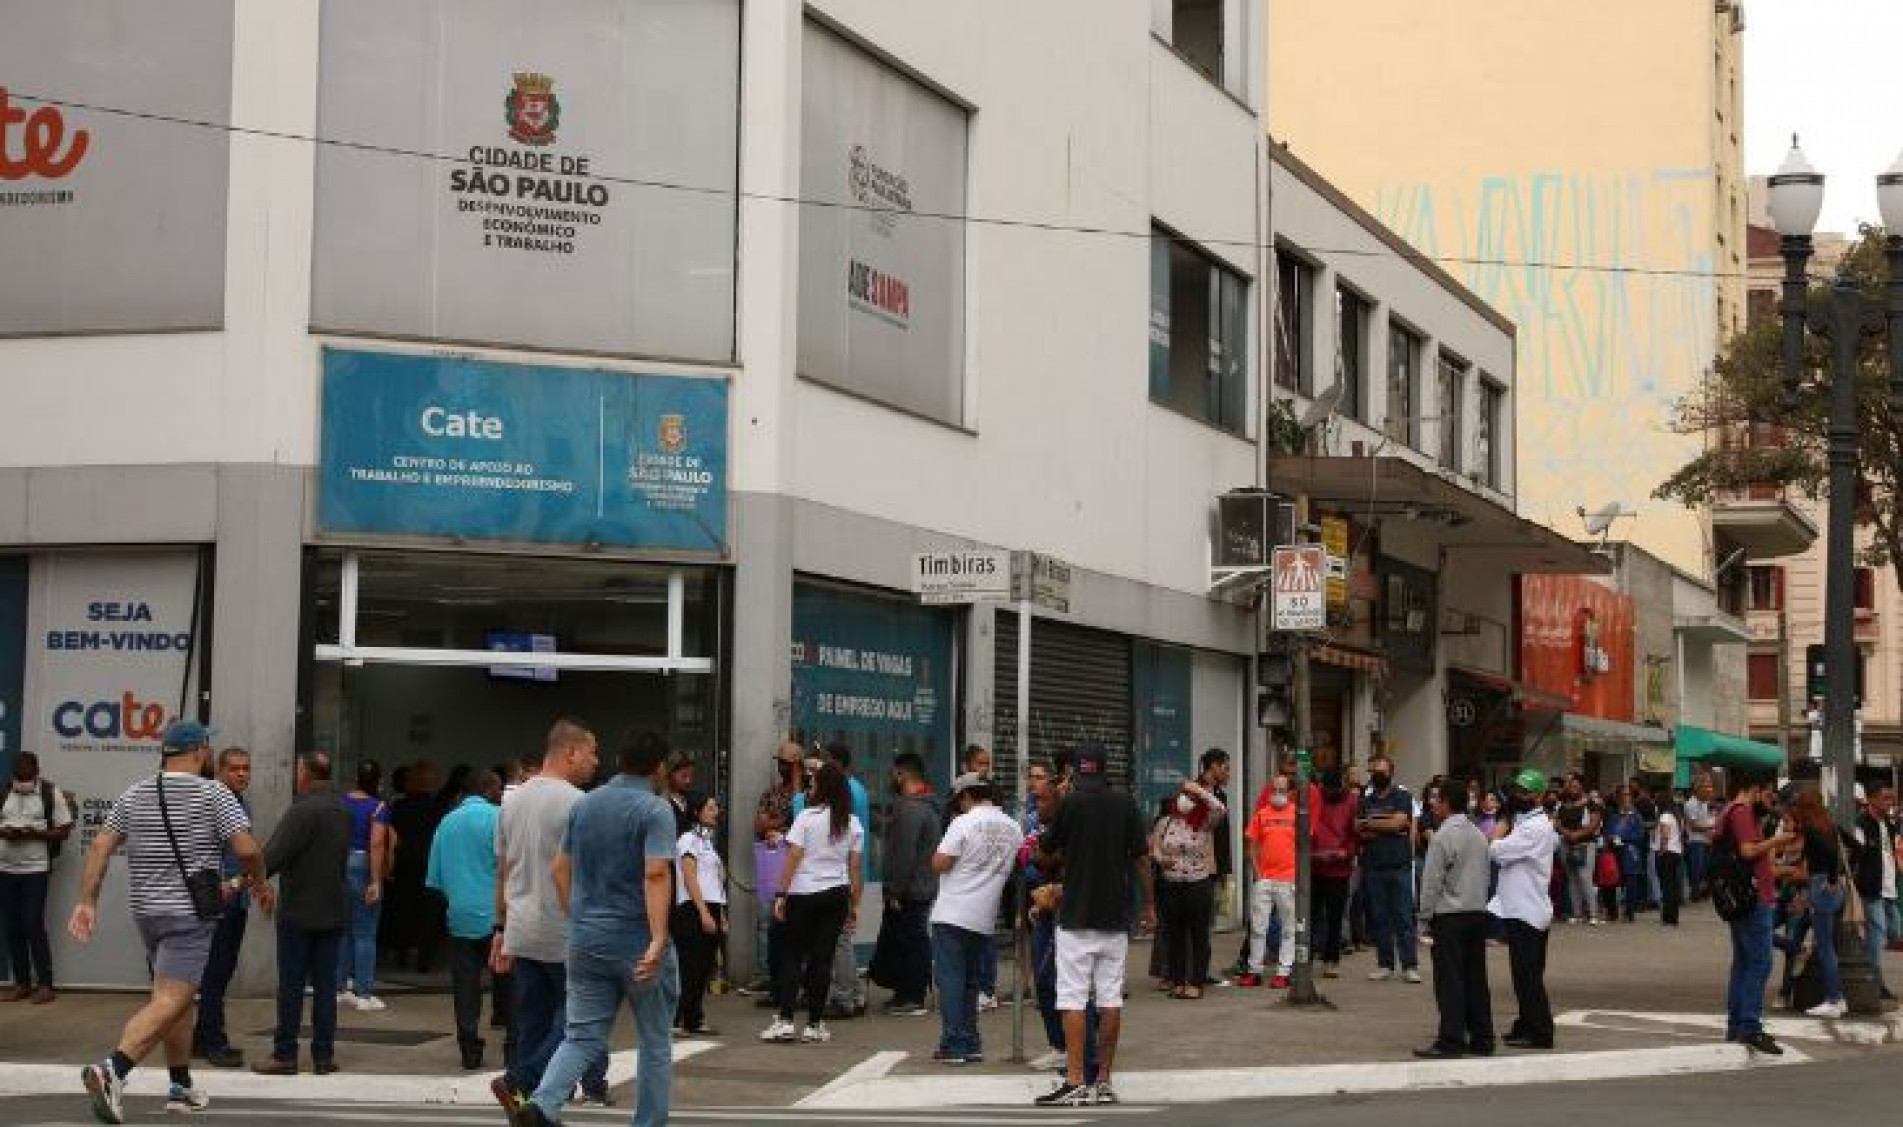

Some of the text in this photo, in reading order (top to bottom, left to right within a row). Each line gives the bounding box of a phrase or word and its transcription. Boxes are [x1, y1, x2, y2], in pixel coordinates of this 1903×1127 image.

[468, 145, 590, 176] CIDADE DE
[450, 166, 609, 207] SÃO PAULO
[457, 199, 601, 225] DESENVOLVIMENTO
[483, 218, 575, 238] ECONÔMICO
[484, 235, 575, 254] E TRABALHO
[420, 405, 503, 440] Cate
[352, 466, 419, 484] TRABALHO
[393, 456, 445, 471] CENTRO
[447, 458, 466, 472] DE
[663, 468, 713, 484] PAULO
[918, 552, 996, 576] Timbiras
[87, 601, 152, 622] SEJA
[47, 630, 191, 651] BEM-VINDO
[819, 645, 860, 669] PAINEL
[861, 650, 876, 672] DE
[53, 690, 180, 741] cate
[835, 695, 886, 718] EMPREGO
